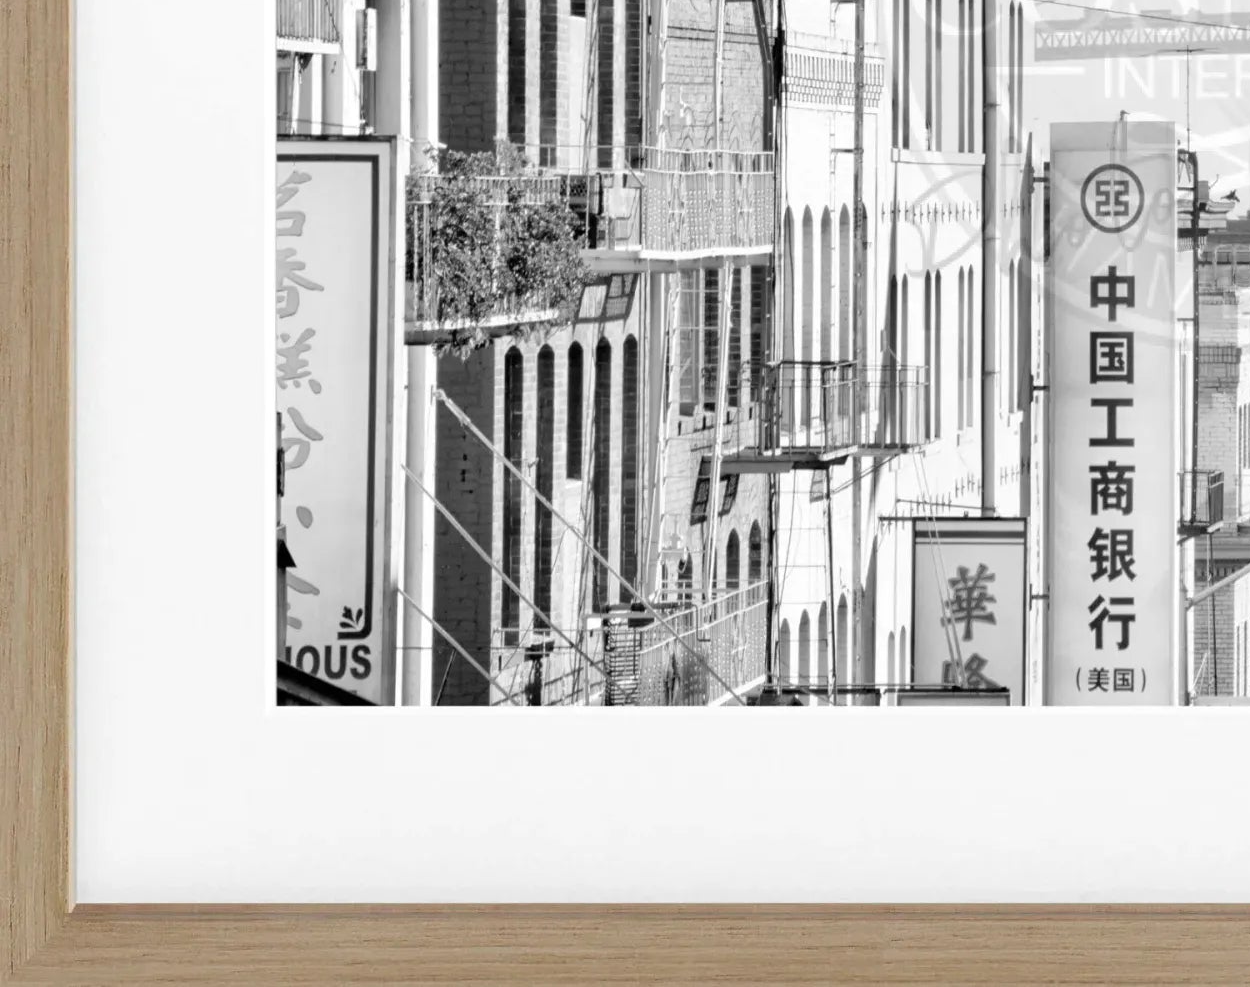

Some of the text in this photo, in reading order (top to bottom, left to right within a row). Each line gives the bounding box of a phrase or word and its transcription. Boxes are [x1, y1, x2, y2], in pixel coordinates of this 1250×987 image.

[1087, 265, 1137, 651] 中国工商银行
[1076, 667, 1147, 694] (美国)
